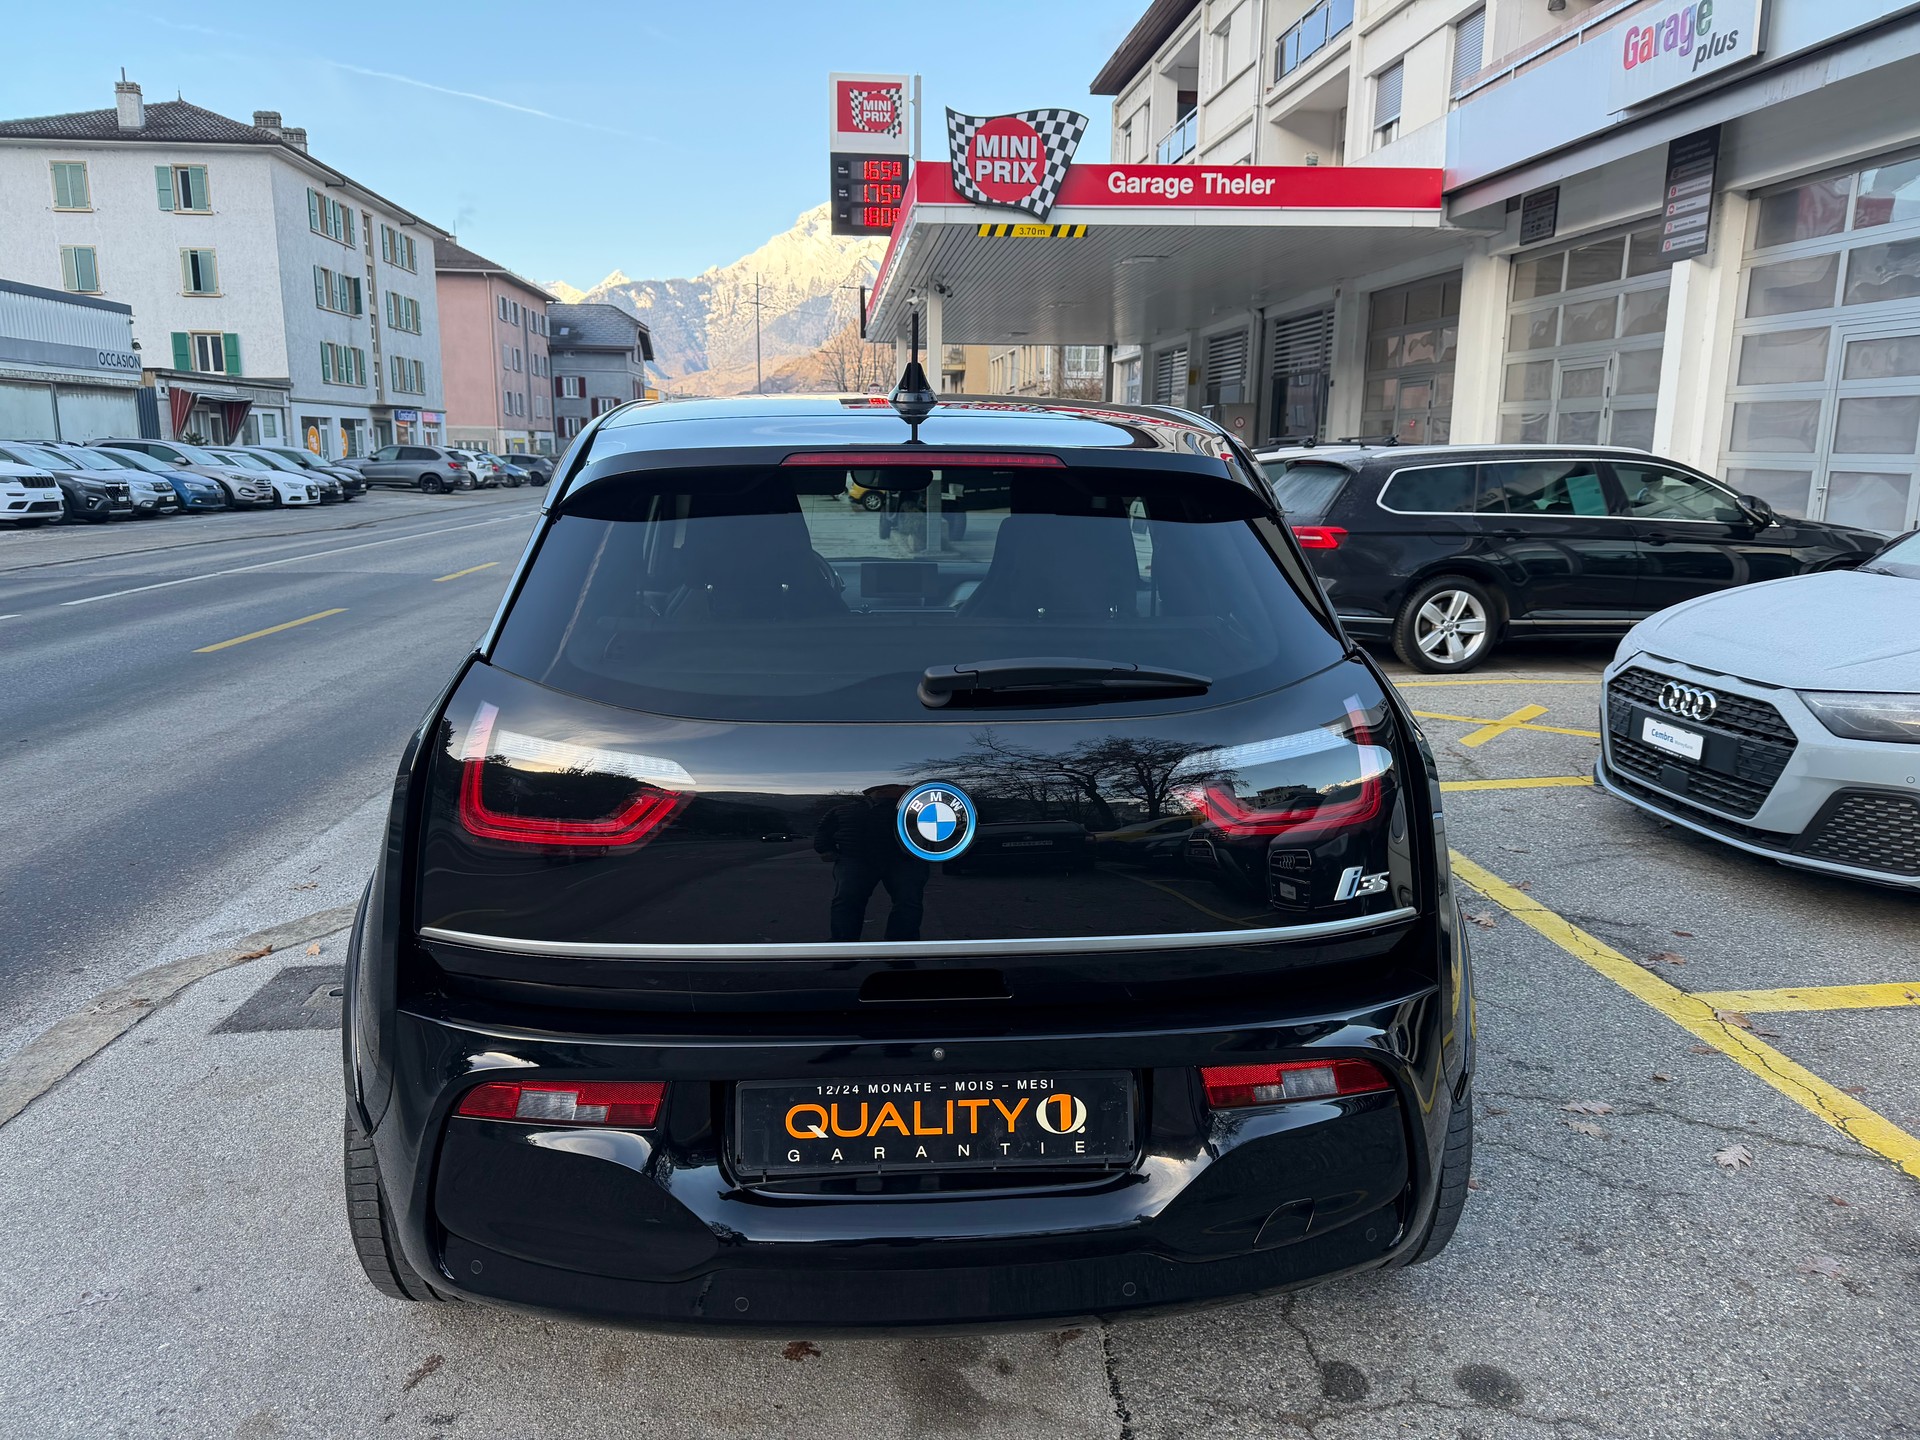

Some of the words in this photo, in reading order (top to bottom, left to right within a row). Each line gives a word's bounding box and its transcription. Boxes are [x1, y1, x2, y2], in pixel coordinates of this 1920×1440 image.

[1623, 0, 1713, 70] Garage
[1692, 29, 1739, 72] plus
[863, 100, 891, 111] MINI
[863, 111, 892, 122] PRIX
[976, 134, 1038, 159] MINI
[975, 160, 1038, 184] PRIX
[1107, 171, 1194, 199] Garage
[1200, 172, 1276, 195] Theler
[98, 351, 141, 369] OCCASION
[1651, 728, 1674, 743] Cembra
[910, 791, 963, 813] BMW
[816, 1084, 860, 1096] 12/24
[868, 1082, 932, 1094] MONATE
[955, 1080, 994, 1091] MOIS
[1016, 1079, 1055, 1090] MESI
[785, 1097, 1030, 1139] QUALITY
[787, 1140, 1086, 1162] GARANTIE
